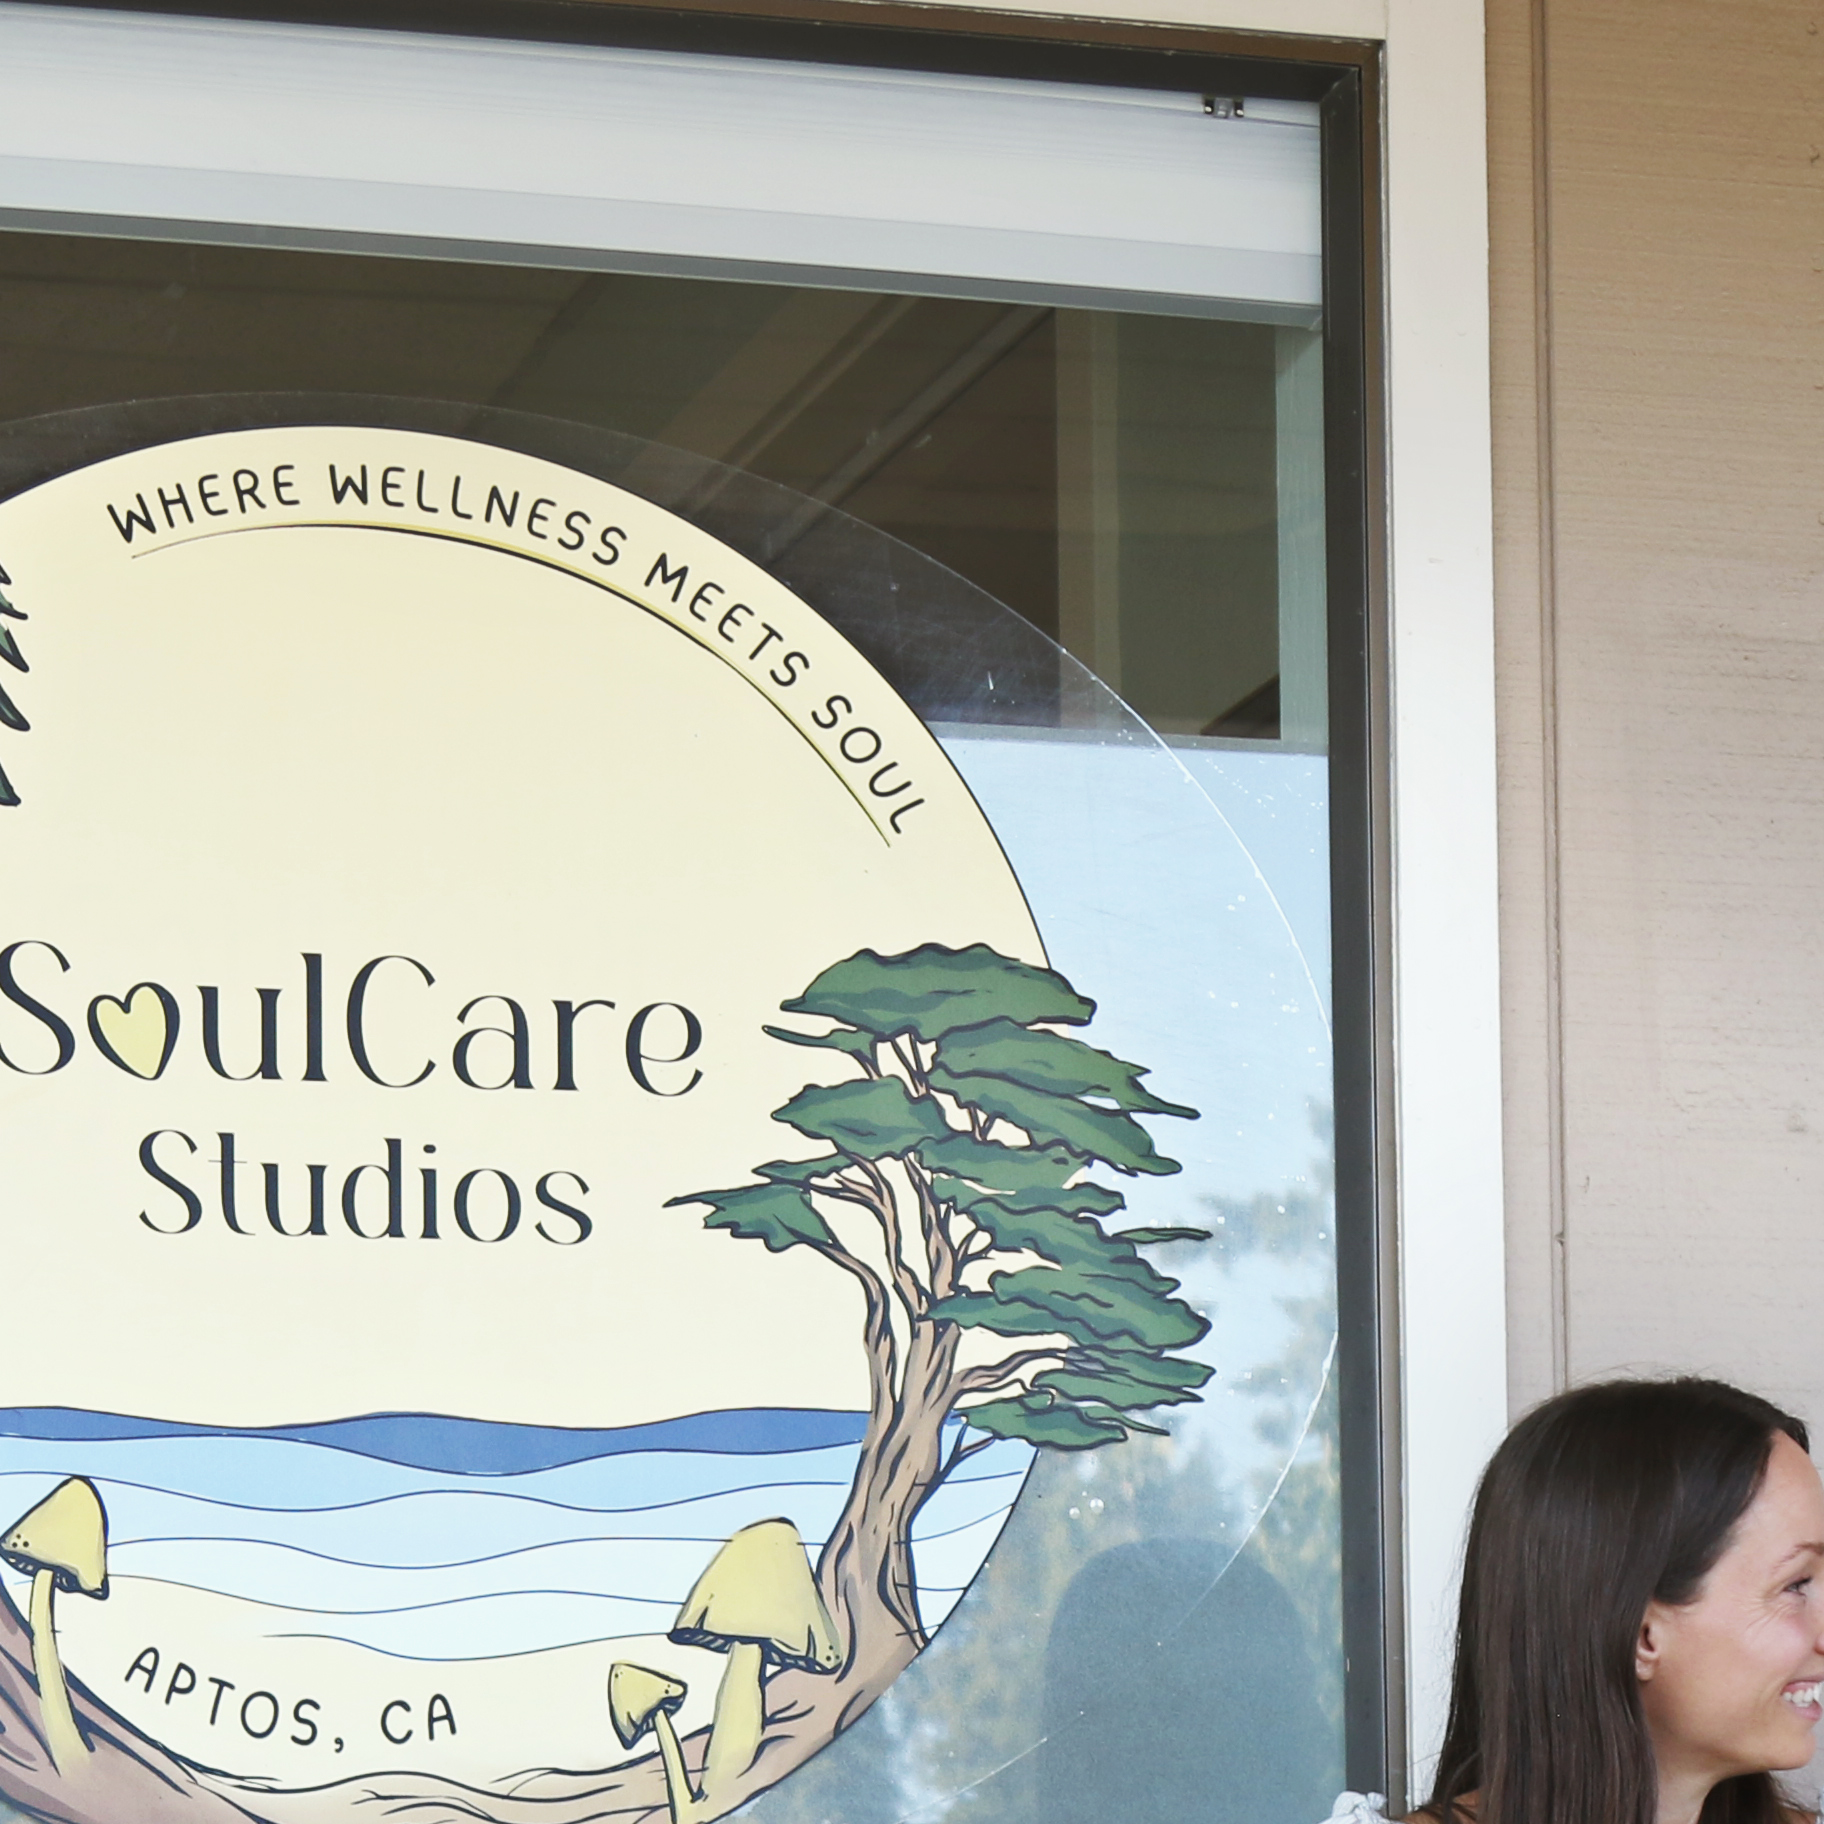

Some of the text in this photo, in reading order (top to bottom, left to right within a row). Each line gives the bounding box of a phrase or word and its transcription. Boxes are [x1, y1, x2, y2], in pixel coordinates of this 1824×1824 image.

[106, 464, 925, 834] WHERE WELLNESS MEETS SOUL
[138, 1130, 593, 1245] Studios
[124, 1646, 457, 1754] APTOS, CA
